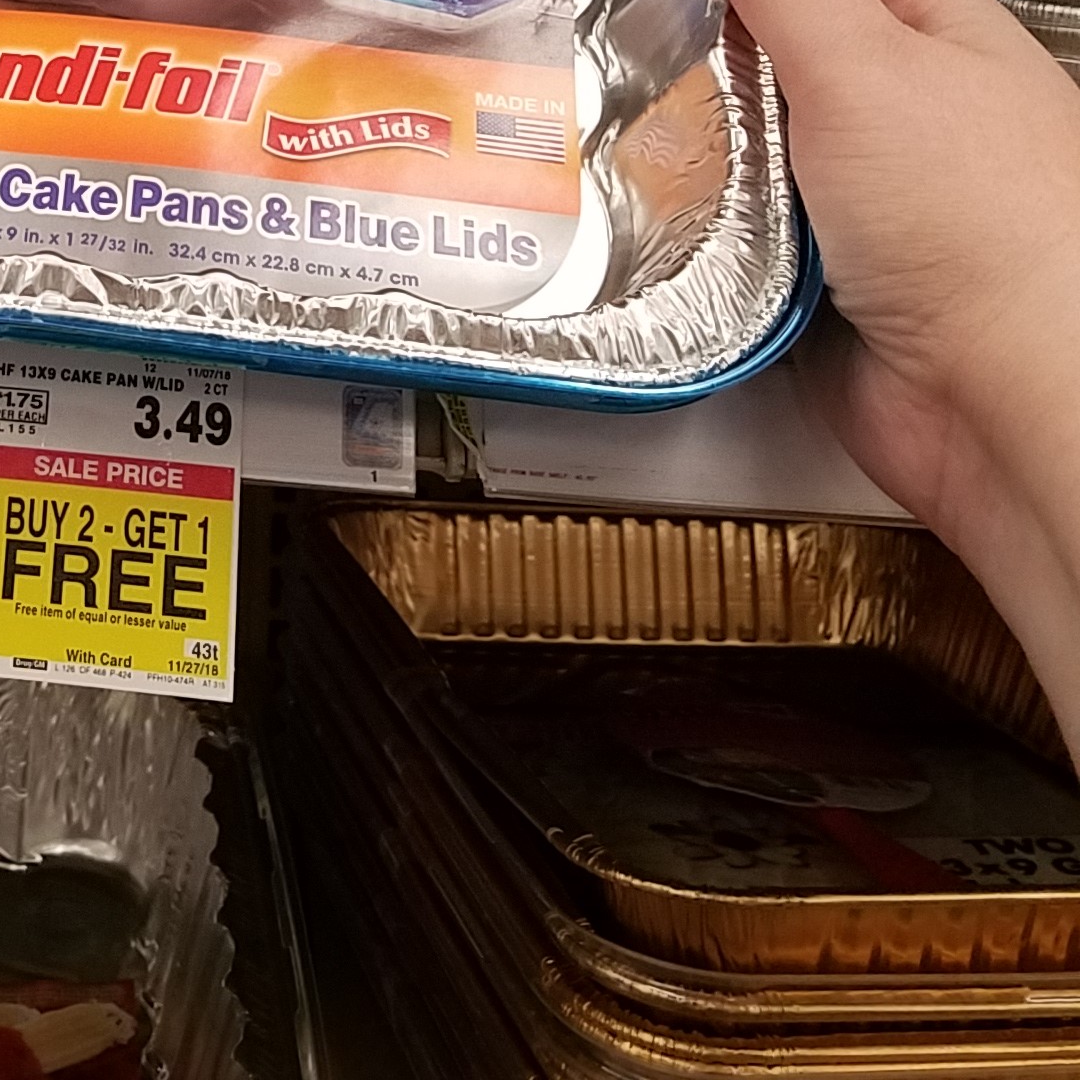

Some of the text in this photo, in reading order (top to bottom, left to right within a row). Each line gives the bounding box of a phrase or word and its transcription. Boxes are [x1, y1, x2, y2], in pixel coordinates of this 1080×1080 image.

[475, 92, 566, 115] MADE IN
[278, 113, 431, 152] with Lids
[0, 168, 119, 216] Cake
[131, 180, 248, 231] Pans
[260, 197, 295, 237] &
[309, 200, 420, 251] Blue
[433, 216, 539, 267] Lids
[7, 226, 17, 241] 9
[24, 228, 44, 244] in.
[49, 234, 60, 245] x
[66, 232, 73, 247] 1
[81, 233, 126, 253] 27/32
[134, 238, 154, 255] in.
[169, 242, 207, 262] 32.4
[212, 250, 240, 265] cm
[245, 255, 256, 267] x
[261, 254, 300, 273] 22.8
[305, 261, 334, 277] cm
[339, 267, 350, 279] x
[355, 264, 383, 283] 4.7
[390, 272, 419, 287] cm
[21, 365, 56, 380] 13X9
[61, 368, 101, 385] CAKE
[107, 373, 138, 388] PAN
[142, 376, 184, 392] W/LID
[145, 363, 156, 373] 12
[187, 367, 231, 380] 11/07/18
[204, 383, 228, 396] 2 CT
[20, 410, 45, 422] EACH
[134, 395, 232, 445] 3.49
[34, 455, 183, 489] SALE PRICE
[5, 496, 209, 554] BUY 2 GET 1
[2, 538, 207, 620] FREE
[15, 602, 187, 632] Free item of equal or lesser value
[66, 649, 132, 668] With Card
[192, 641, 218, 661] 43t
[168, 660, 218, 676] 11/27/18
[963, 836, 1075, 855] TWO
